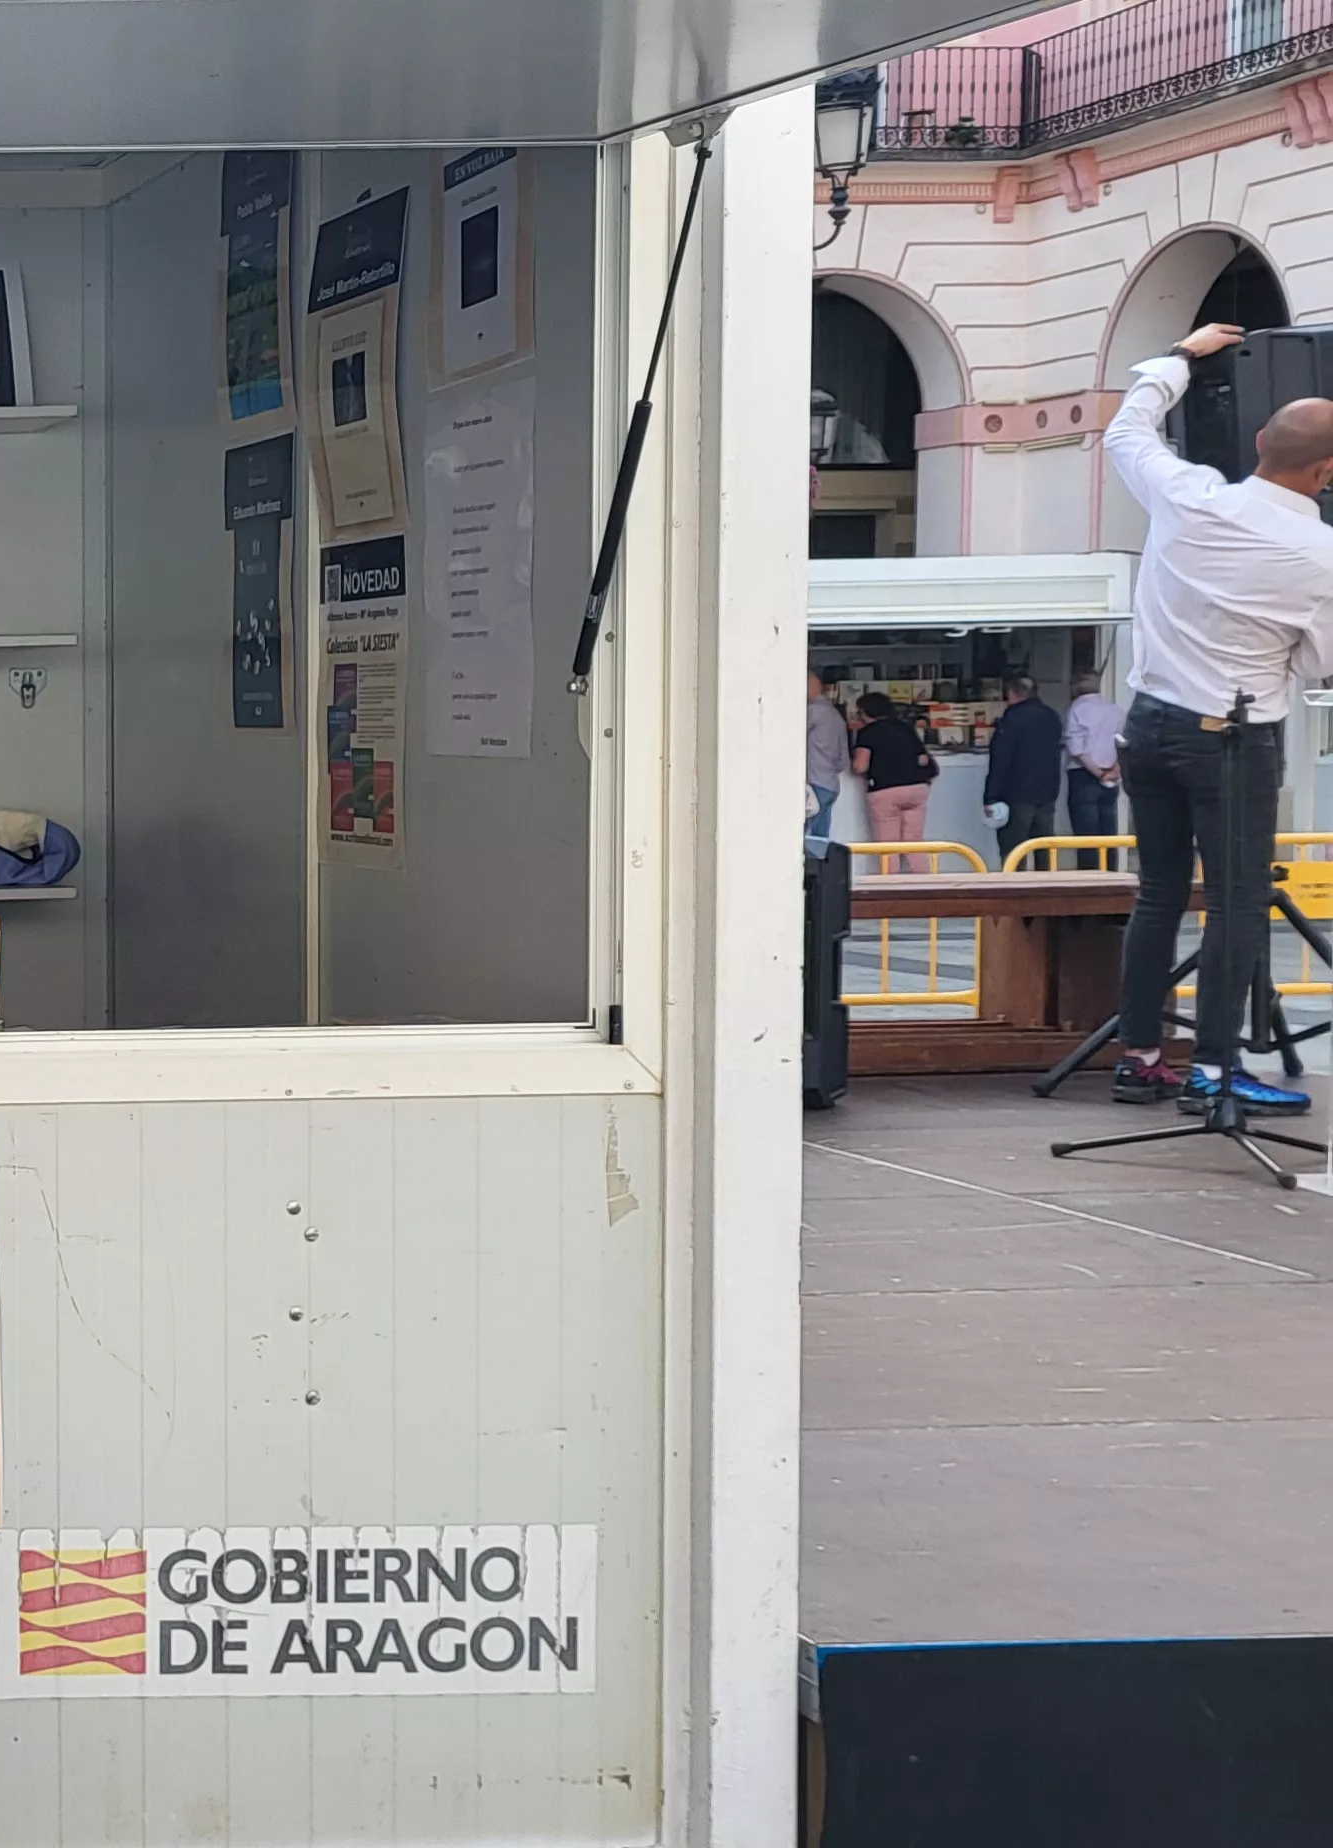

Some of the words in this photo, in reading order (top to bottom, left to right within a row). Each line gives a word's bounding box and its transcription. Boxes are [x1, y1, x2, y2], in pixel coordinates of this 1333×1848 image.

[343, 567, 400, 595] NOVEDAD
[157, 1546, 523, 1604] GOBIERNO
[158, 1619, 249, 1675] DE
[270, 1616, 579, 1675] ARAGON
